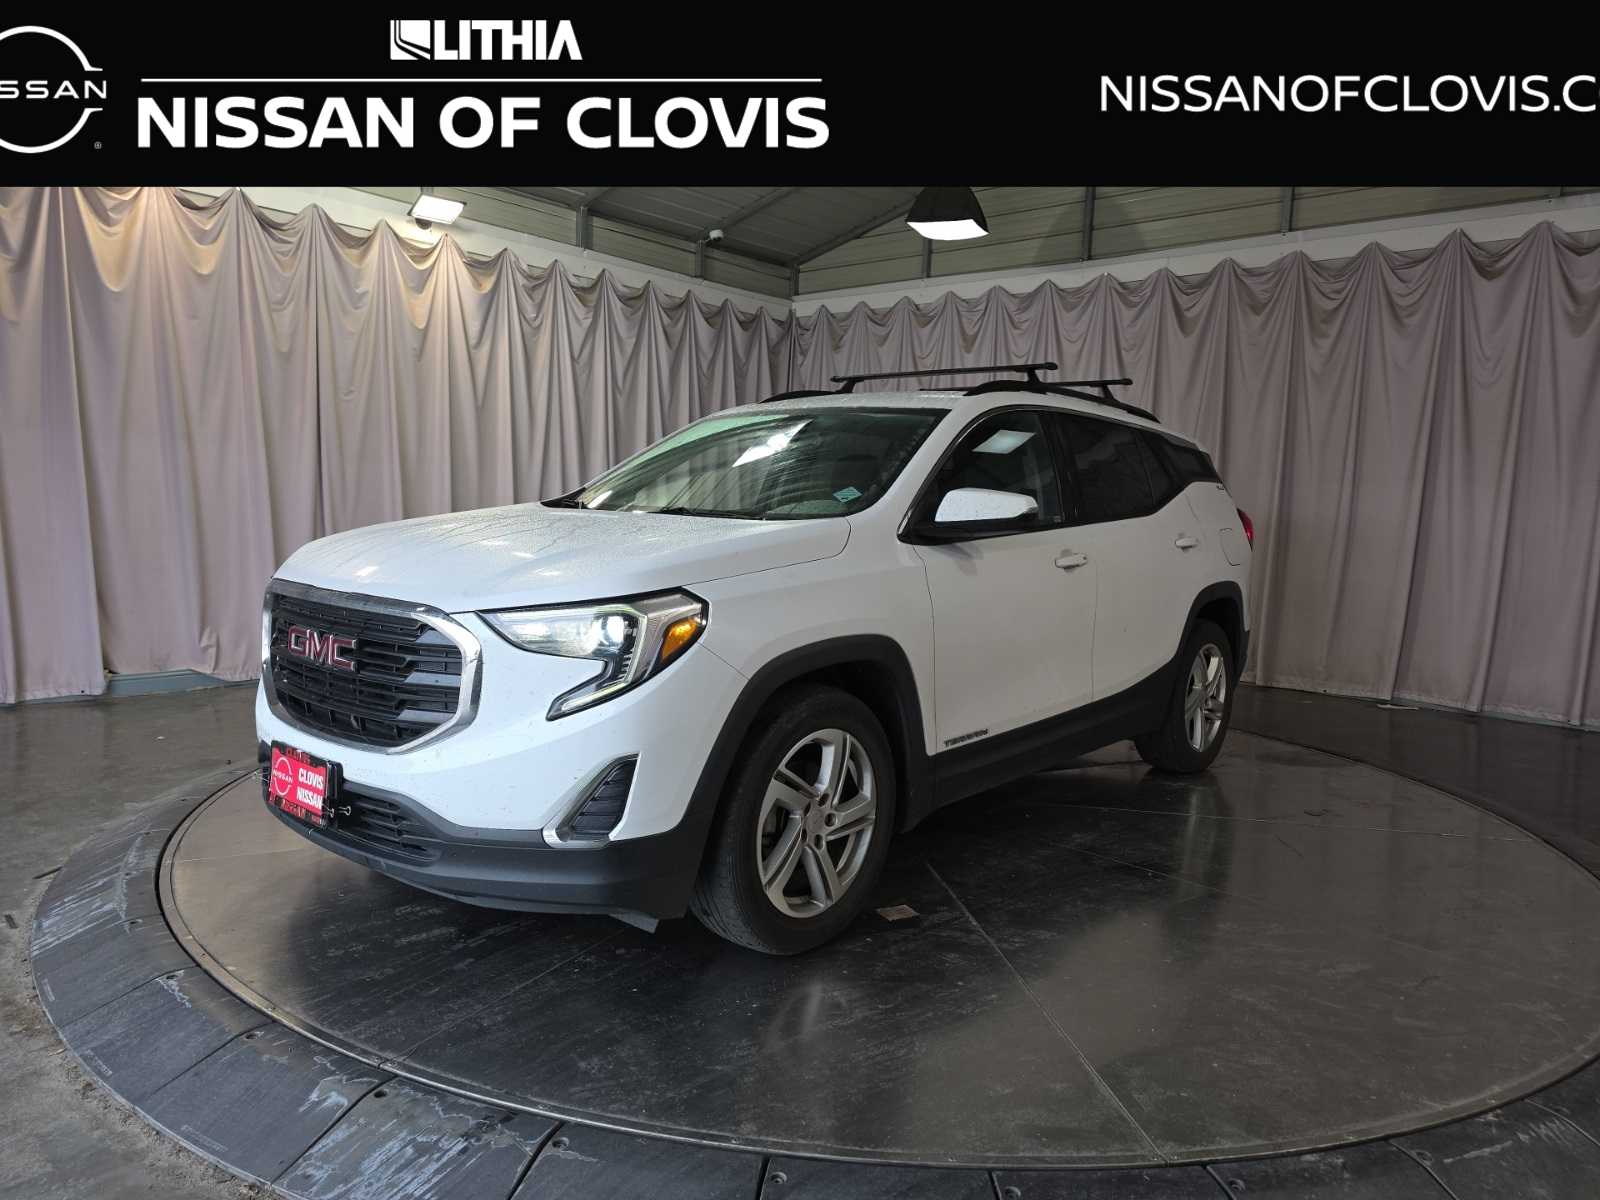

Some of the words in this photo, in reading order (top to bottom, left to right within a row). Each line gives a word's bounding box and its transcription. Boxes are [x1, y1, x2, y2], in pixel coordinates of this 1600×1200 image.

[288, 625, 357, 672] GMC
[298, 768, 324, 790] CLOVIS
[296, 786, 323, 810] NISSAN
